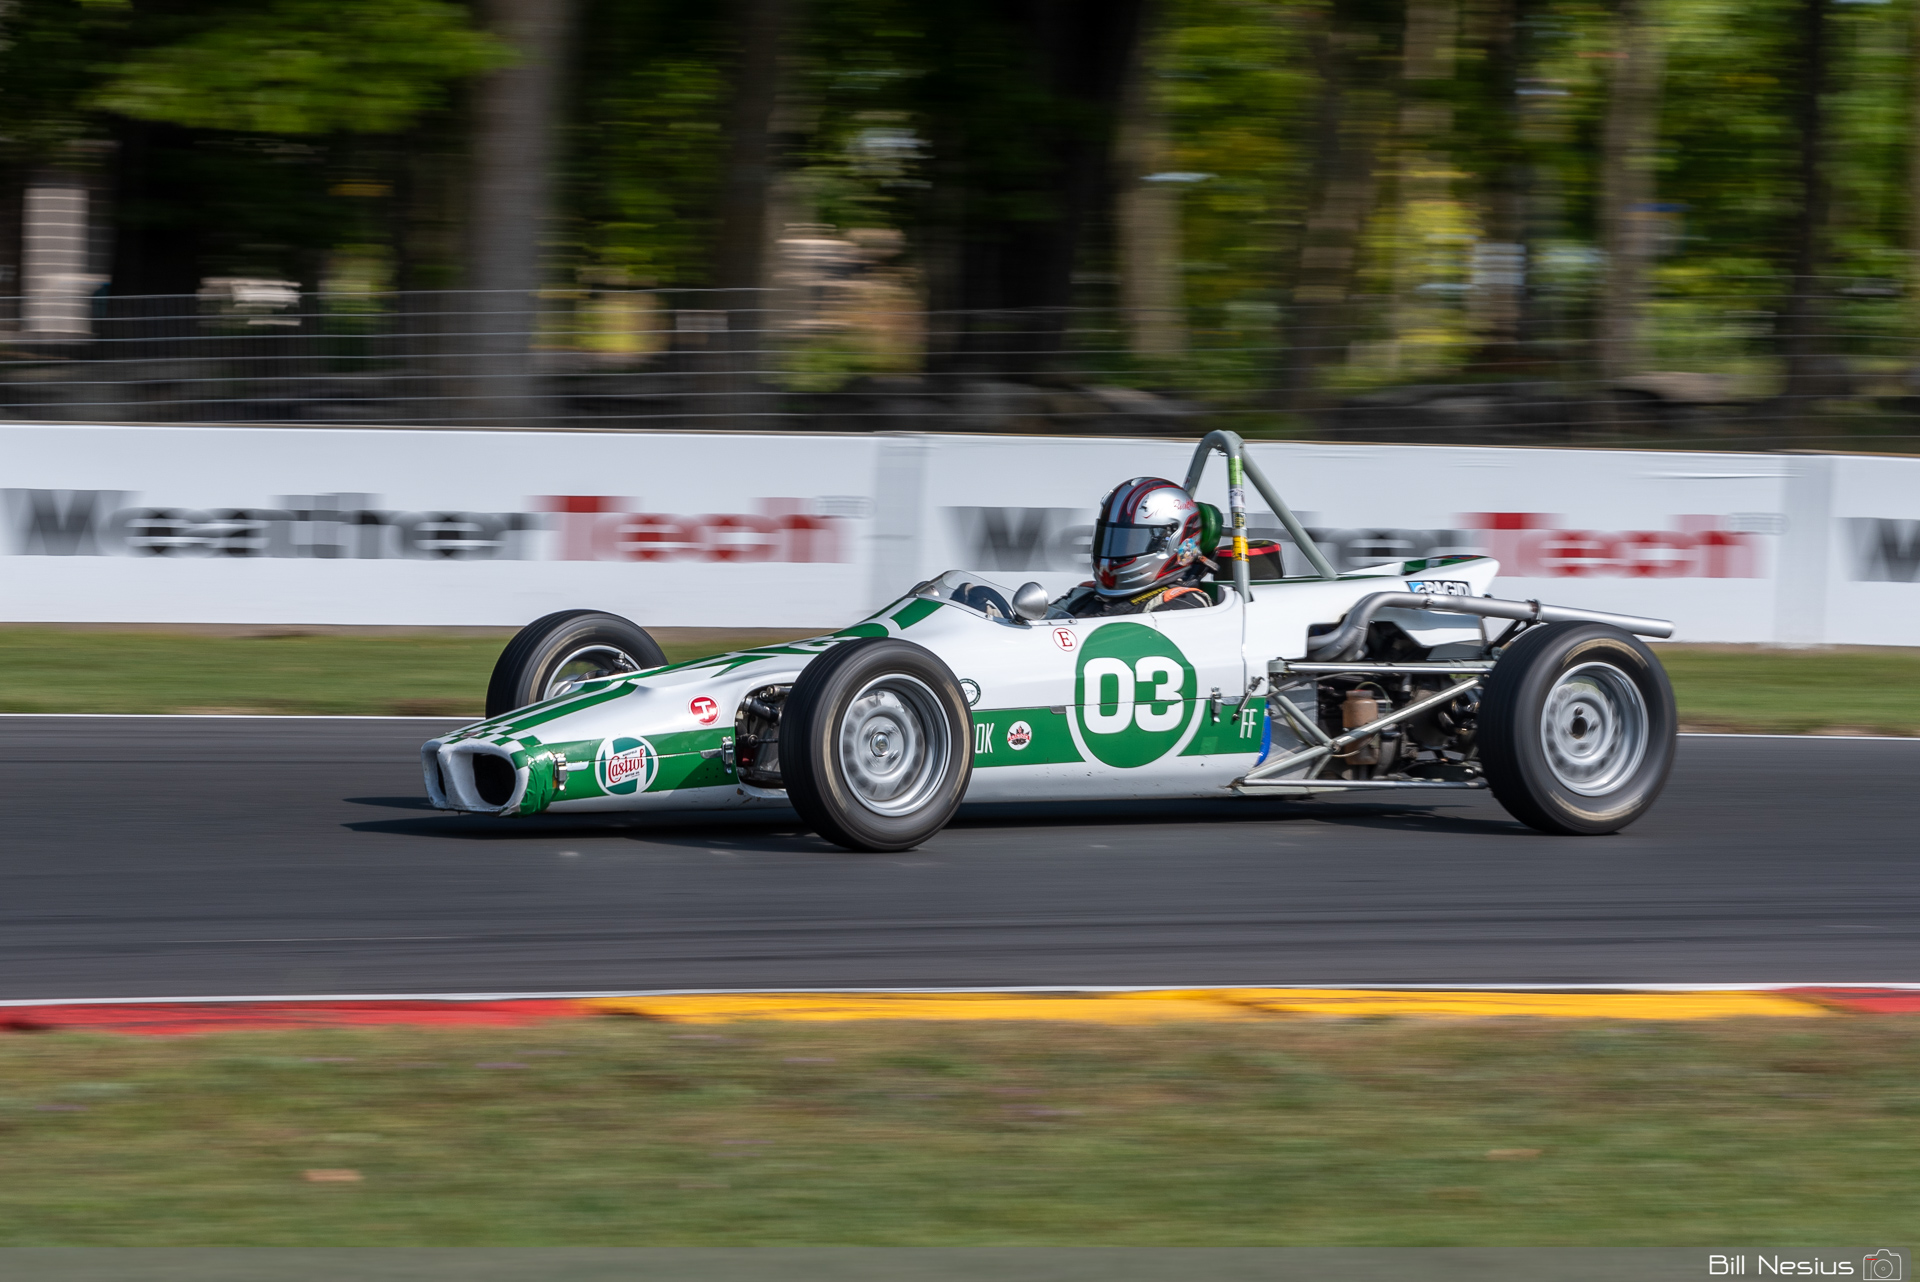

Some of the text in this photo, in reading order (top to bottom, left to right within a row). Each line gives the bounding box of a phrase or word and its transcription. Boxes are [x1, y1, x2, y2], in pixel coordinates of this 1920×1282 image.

[940, 506, 1768, 579] WeherTech
[1057, 631, 1073, 648] E
[1083, 656, 1185, 734] 03
[974, 722, 995, 754] OK
[1239, 708, 1258, 738] FF
[608, 748, 645, 783] Castrol
